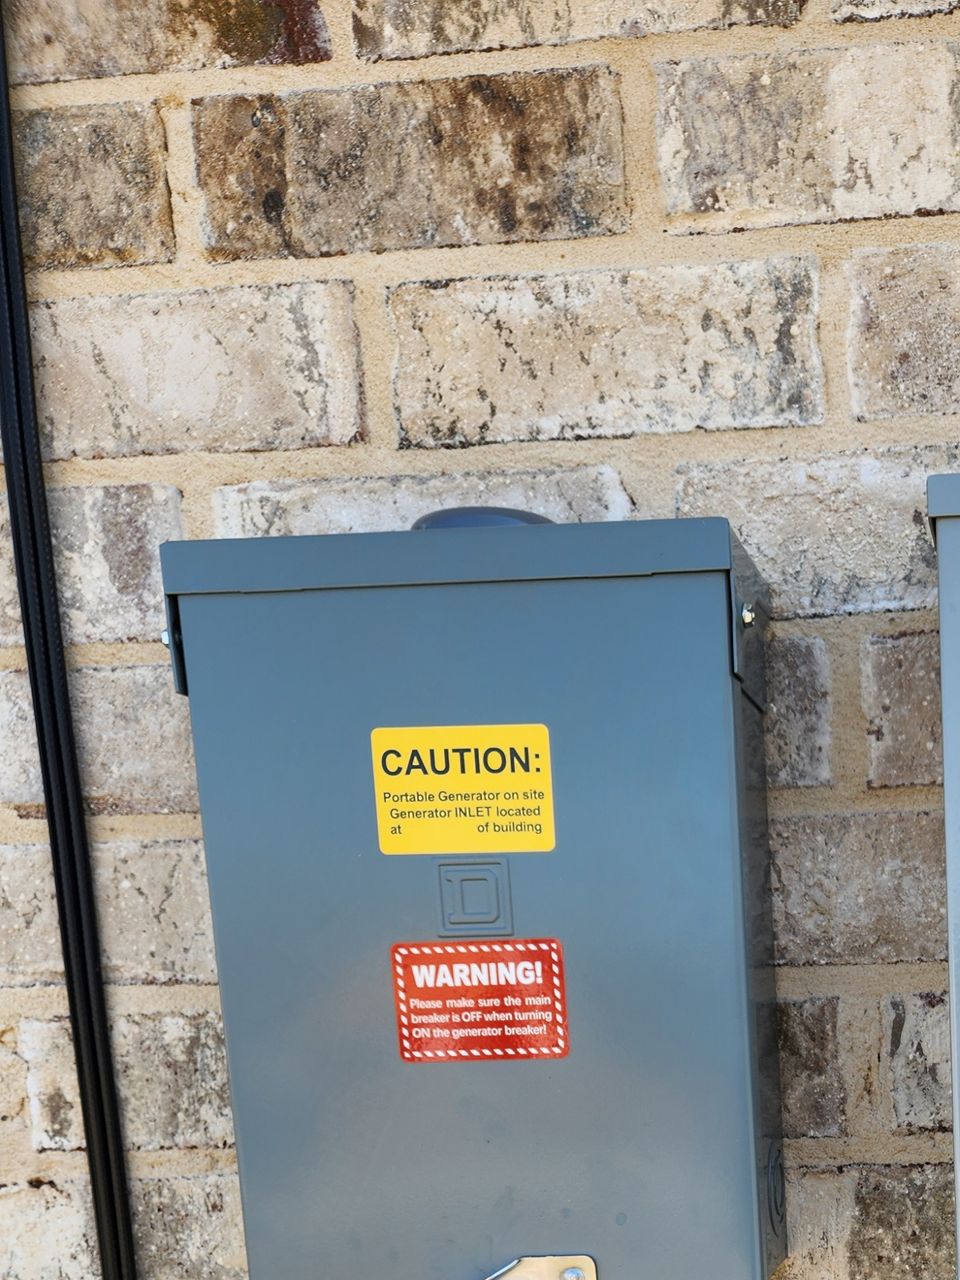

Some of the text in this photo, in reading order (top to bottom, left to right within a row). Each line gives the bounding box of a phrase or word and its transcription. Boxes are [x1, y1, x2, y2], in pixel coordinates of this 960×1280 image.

[381, 747, 541, 776] CAUTION:
[384, 790, 544, 803] Portable Generator on site
[390, 806, 541, 819] Generator INLET located
[391, 824, 402, 834] at
[477, 822, 542, 834] of building
[411, 961, 544, 988] WARNING!
[409, 995, 551, 1009] Please make sure the main
[411, 1010, 552, 1024] breaker is OFF when turning
[412, 1025, 546, 1039] ON the generator breaker!
